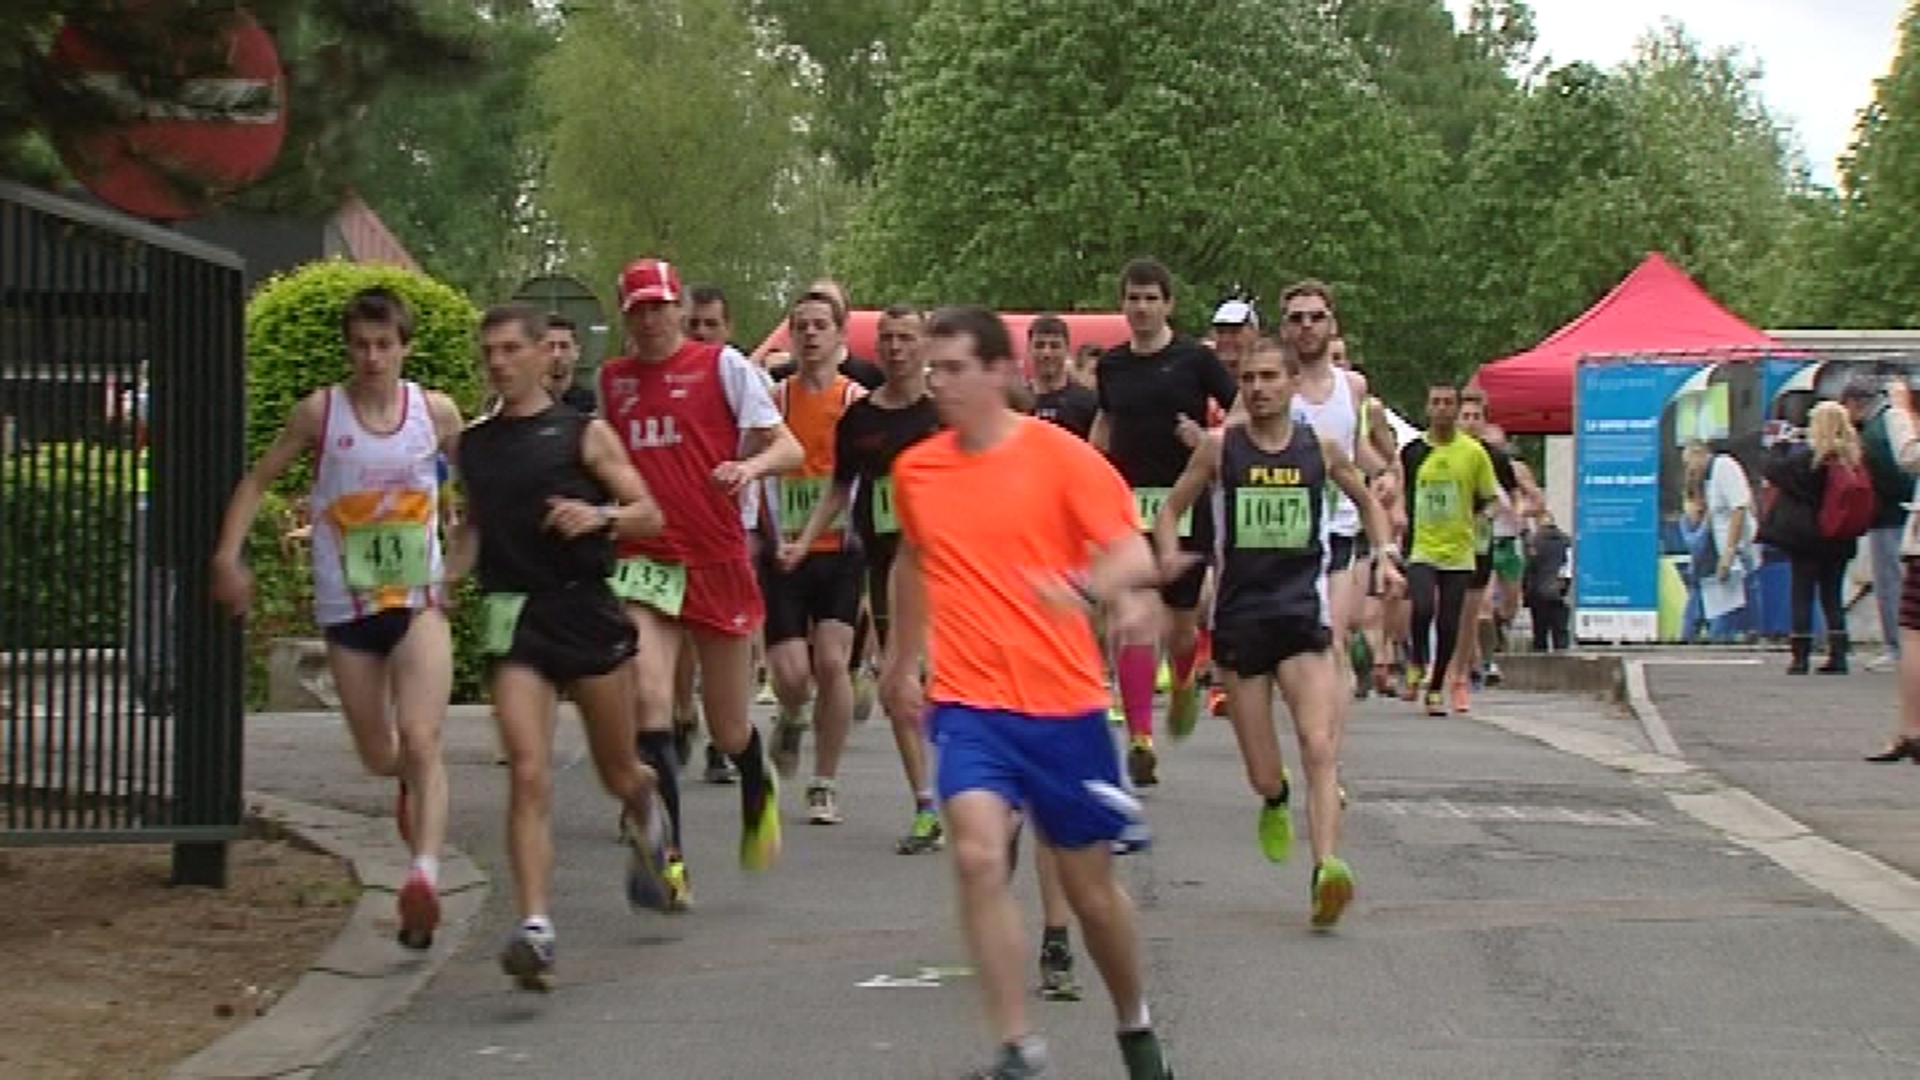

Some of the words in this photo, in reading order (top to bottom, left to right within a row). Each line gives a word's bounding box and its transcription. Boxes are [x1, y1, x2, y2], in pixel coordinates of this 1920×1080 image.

[1249, 467, 1300, 484] FLEU
[1244, 498, 1300, 529] 1047
[363, 534, 403, 569] 43
